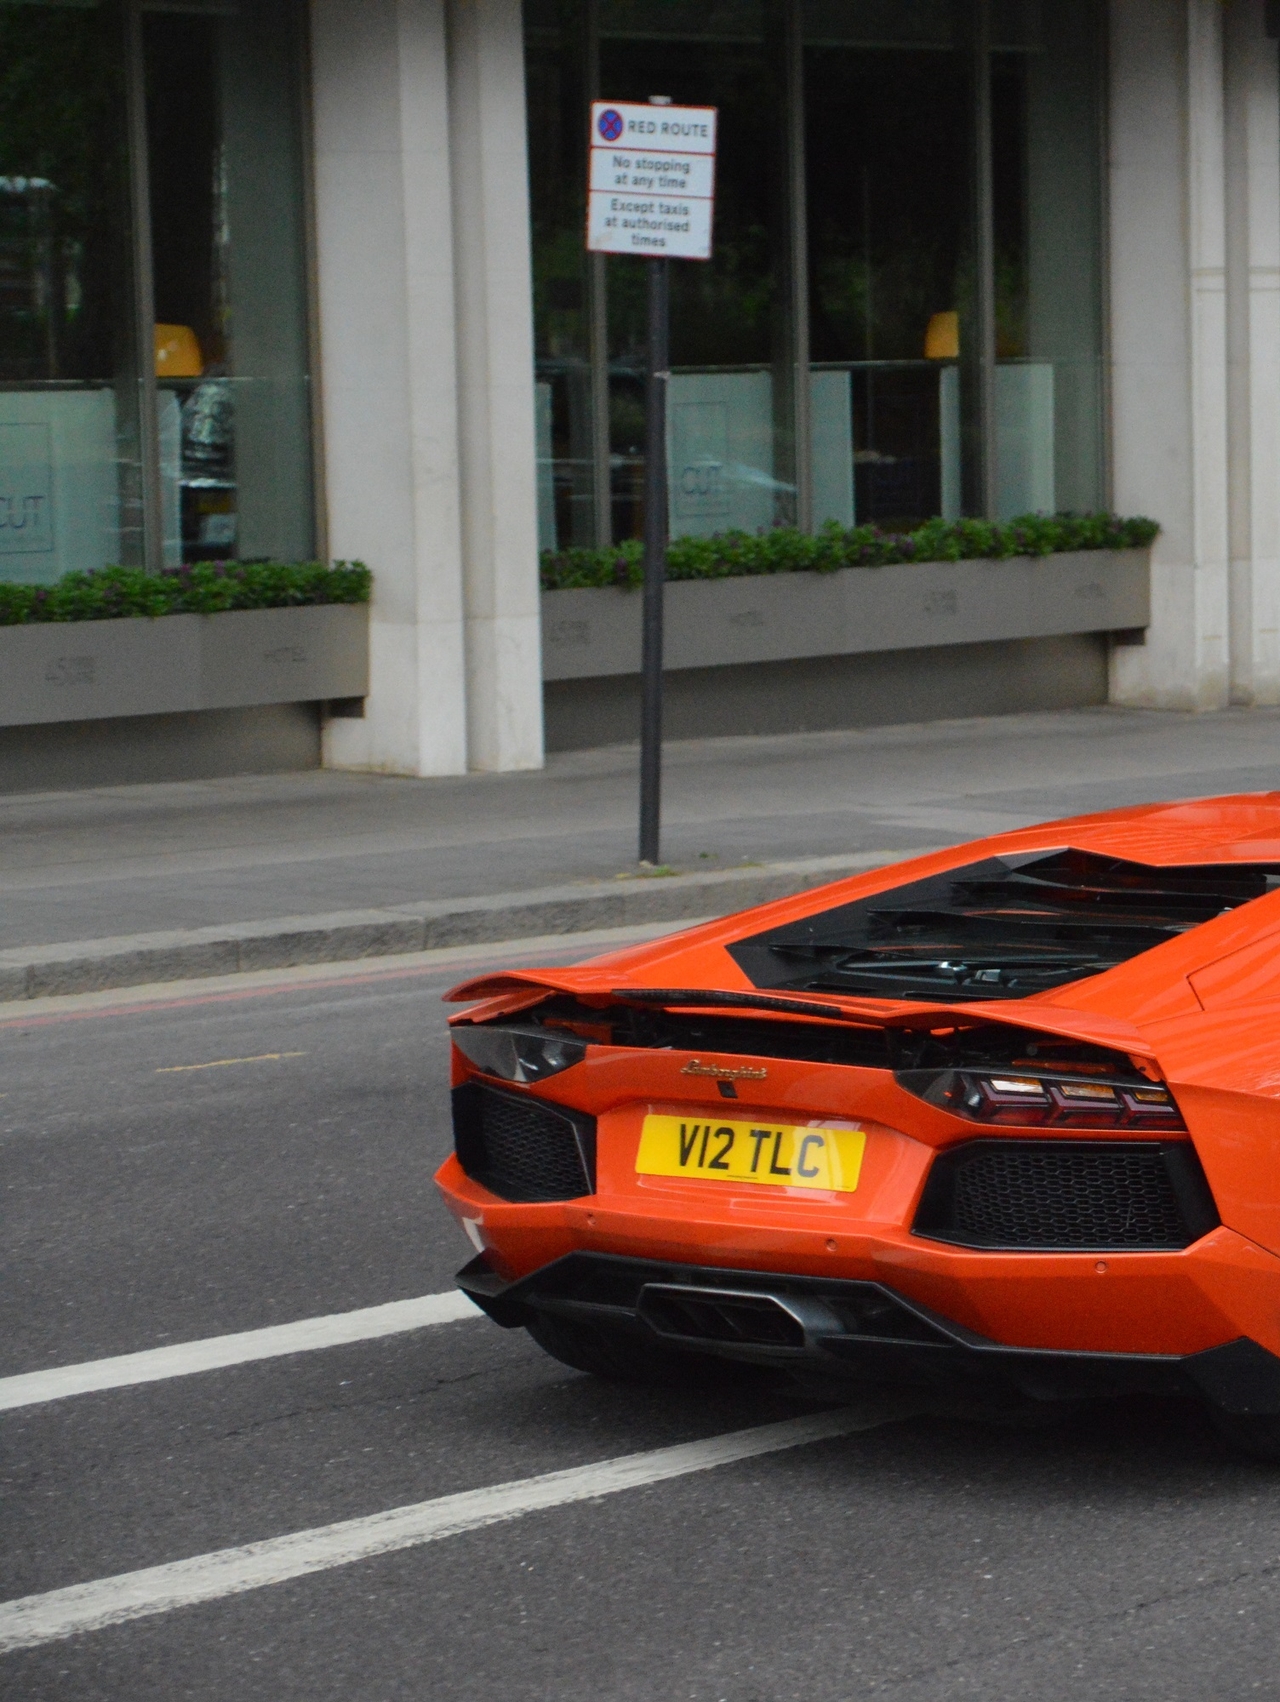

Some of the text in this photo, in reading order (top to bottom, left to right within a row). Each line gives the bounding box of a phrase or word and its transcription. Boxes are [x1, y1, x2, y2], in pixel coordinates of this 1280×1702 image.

[628, 120, 708, 137] RED ROUTE
[613, 155, 690, 174] No stopping
[615, 173, 686, 188] at any time
[611, 199, 689, 215] Except taxis
[605, 216, 690, 232] at authorised
[631, 233, 665, 247] times
[680, 1059, 767, 1081] Lamborghini
[679, 1123, 825, 1178] V12 TLC
